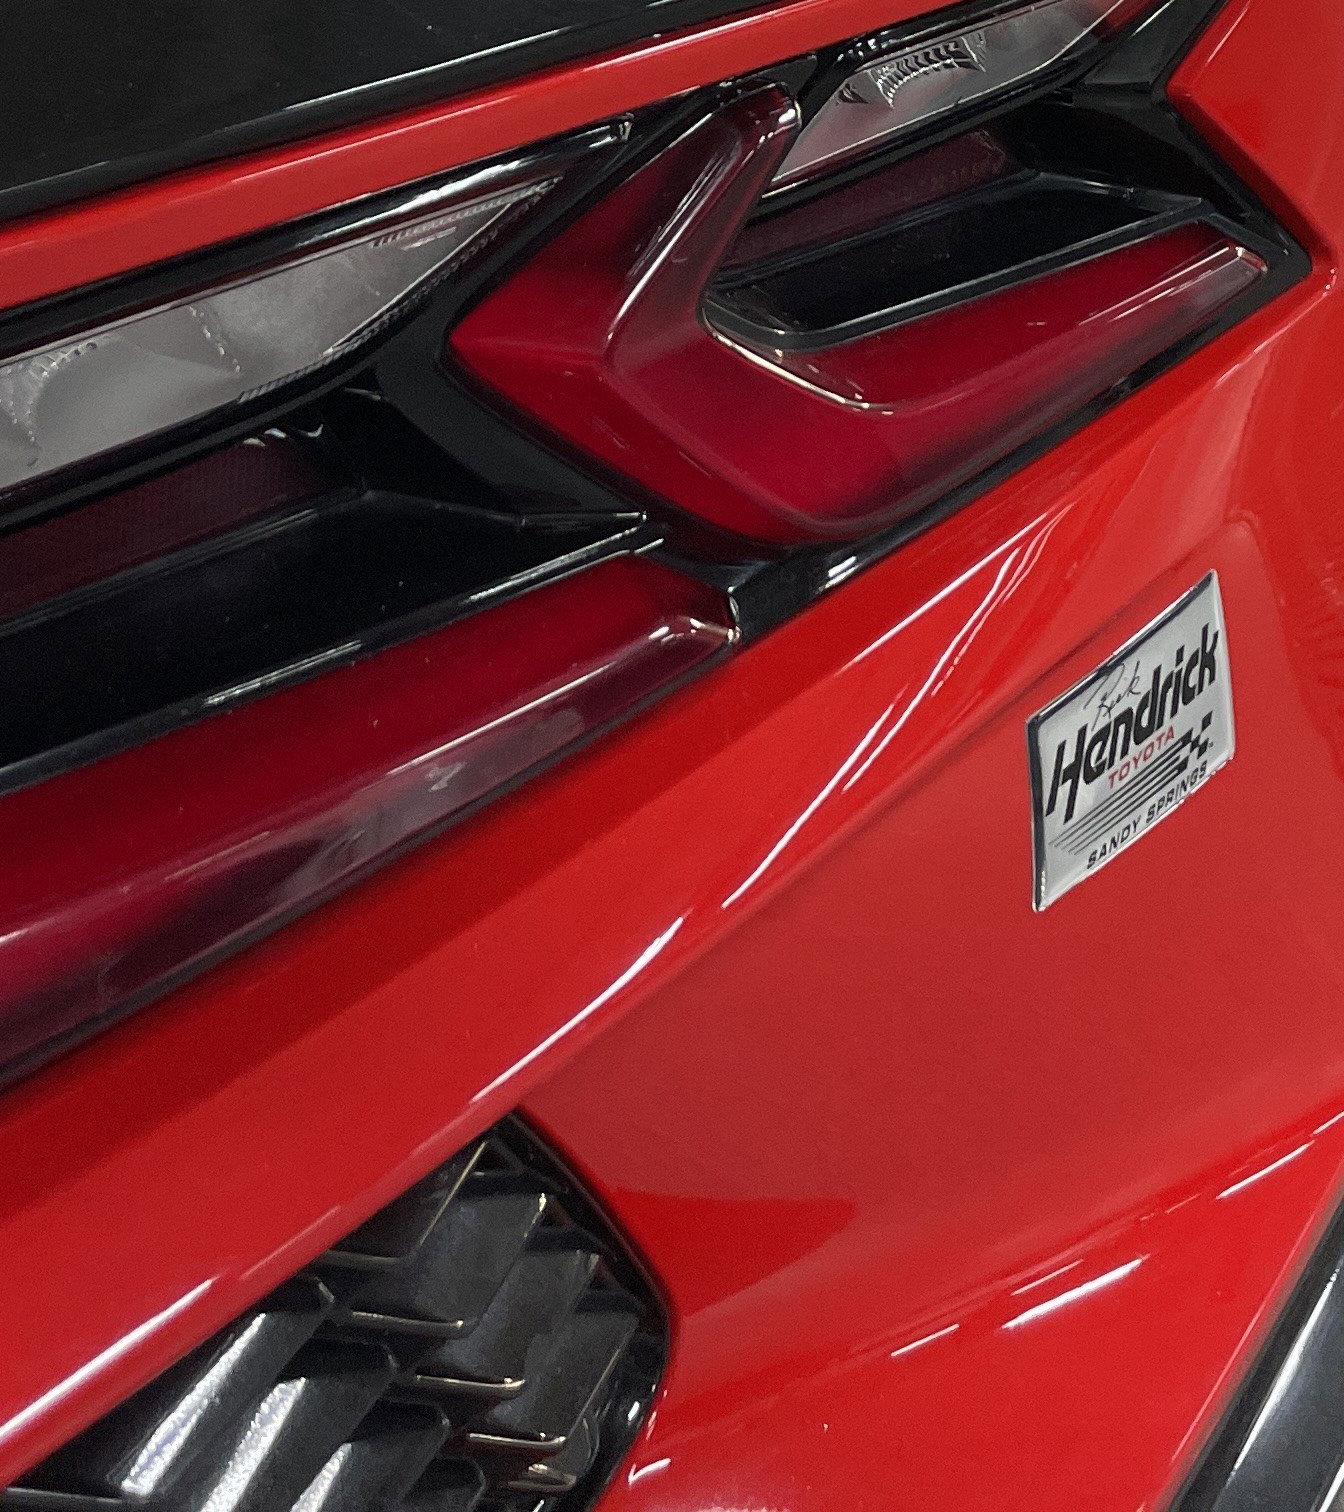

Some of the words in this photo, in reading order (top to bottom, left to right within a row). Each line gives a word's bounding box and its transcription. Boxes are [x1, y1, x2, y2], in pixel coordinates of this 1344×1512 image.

[1045, 622, 1219, 824] Hendrick
[1108, 725, 1175, 789] TOYOTA
[1087, 815, 1141, 869] SANDY
[1146, 759, 1208, 824] SPRINGS
